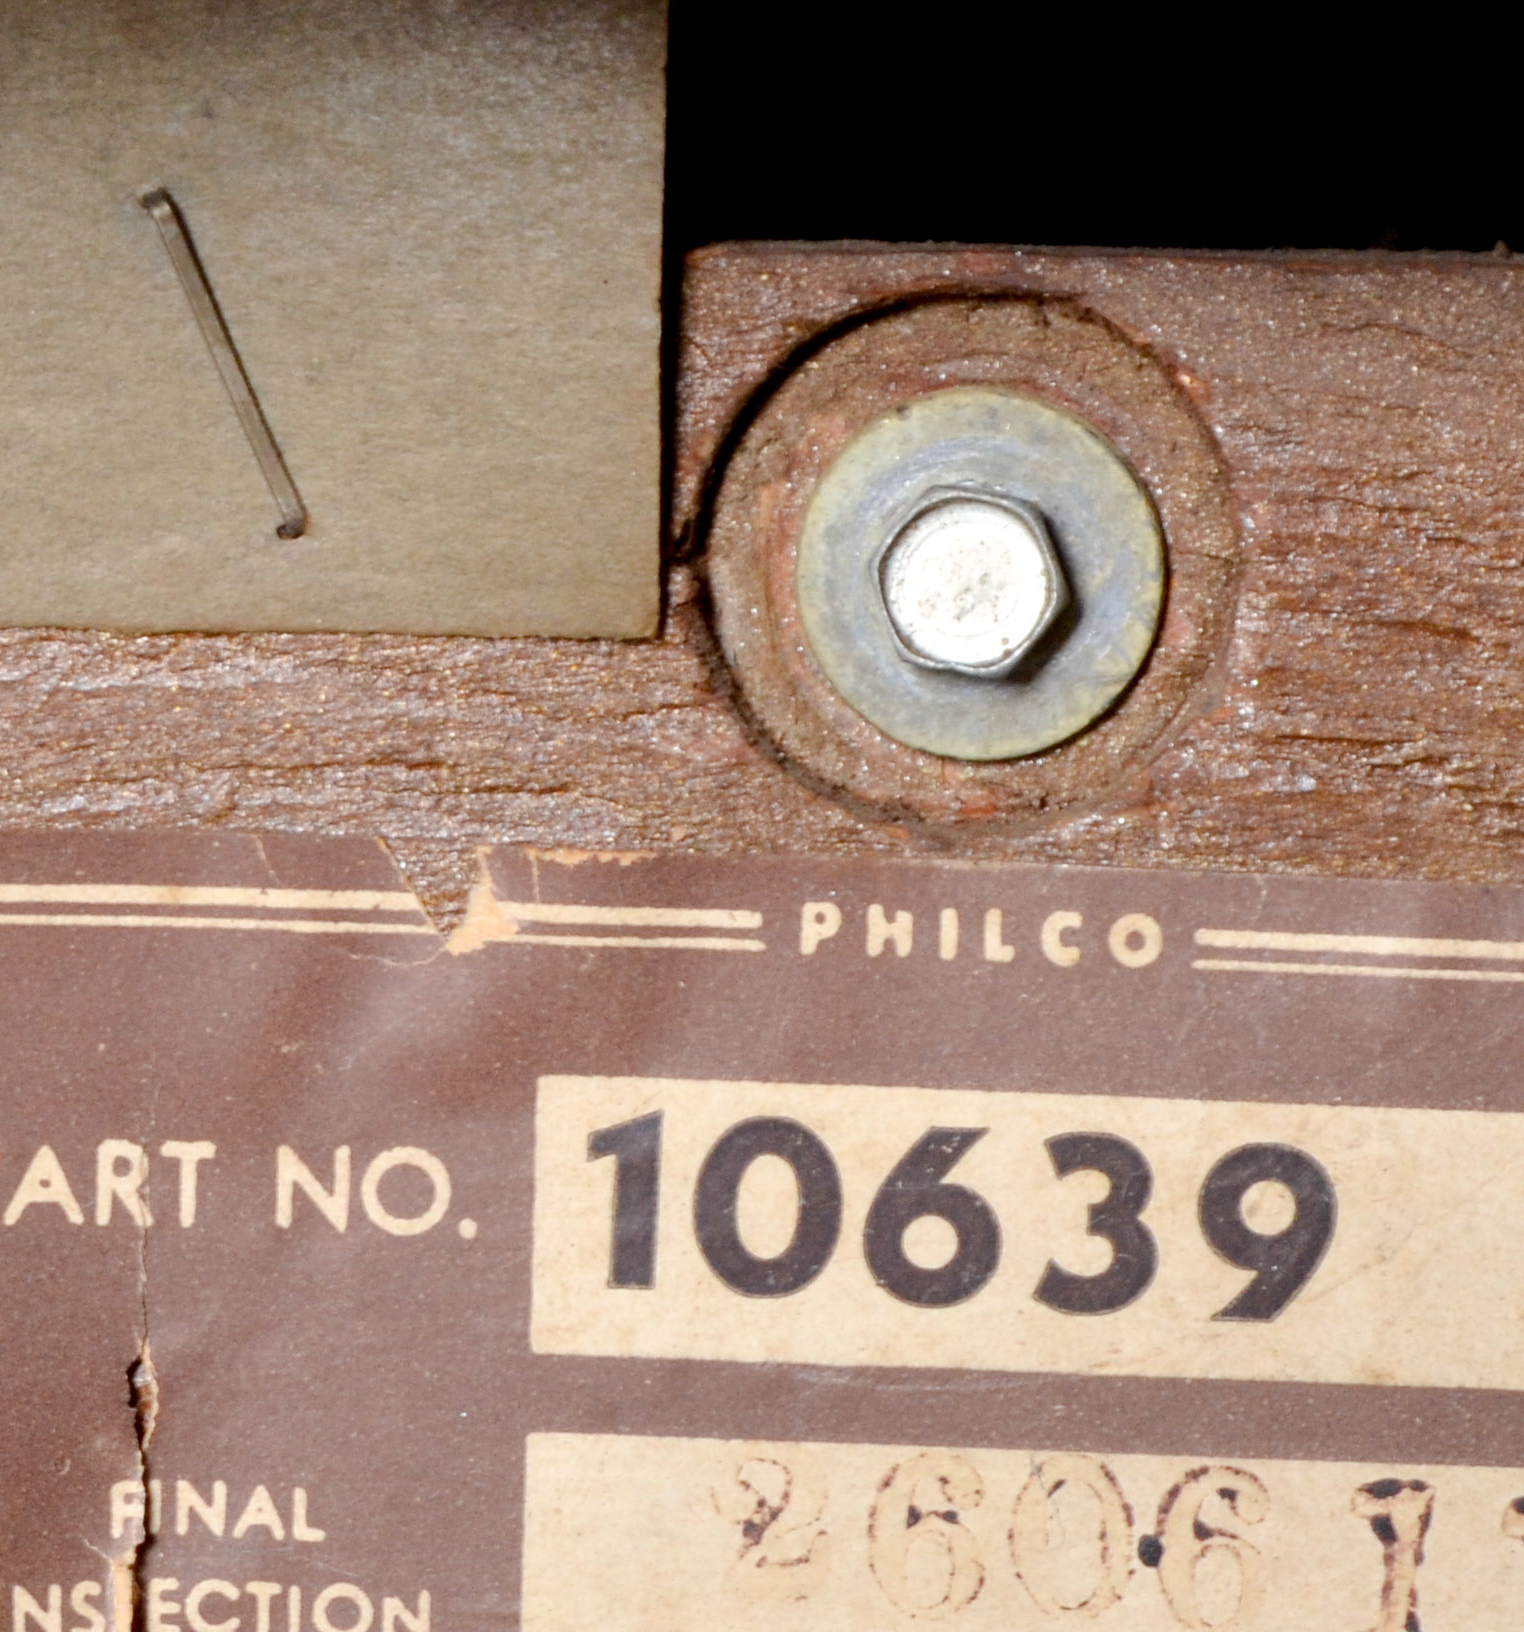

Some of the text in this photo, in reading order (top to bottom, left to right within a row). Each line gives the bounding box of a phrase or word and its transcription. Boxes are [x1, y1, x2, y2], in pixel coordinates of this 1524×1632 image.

[800, 901, 1165, 968] PHILCO
[276, 1145, 478, 1240] NO.
[585, 1108, 1339, 1323] 10639
[109, 1479, 326, 1542] FINAL
